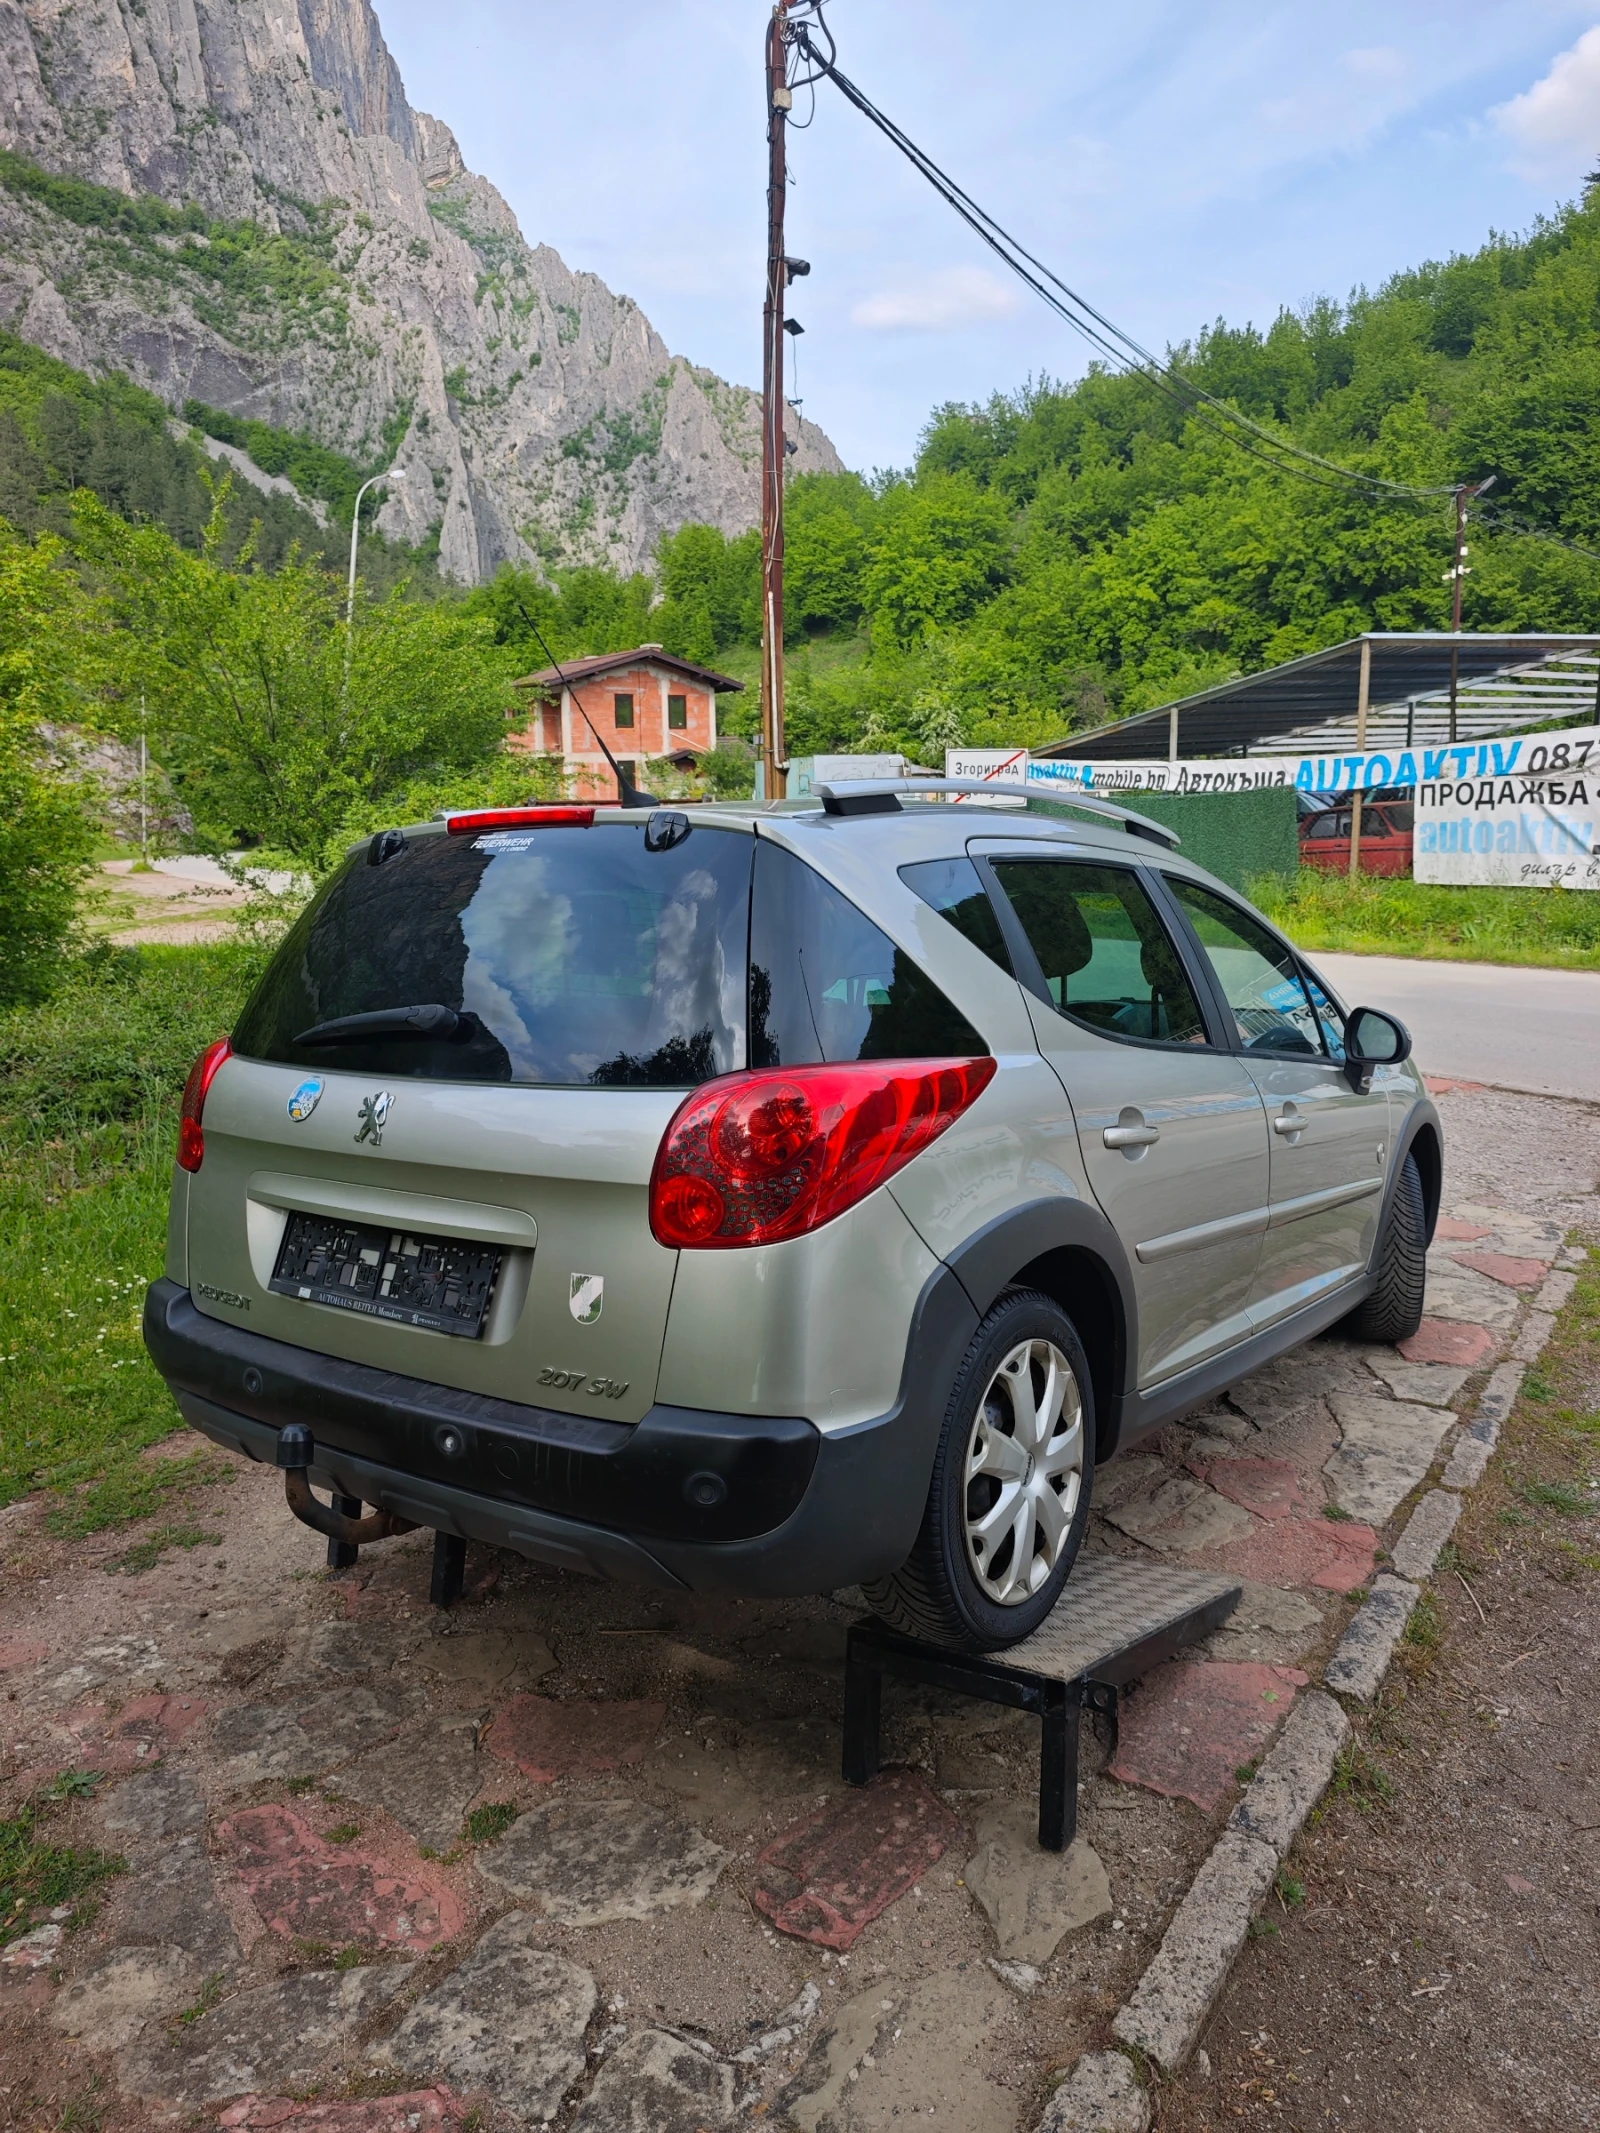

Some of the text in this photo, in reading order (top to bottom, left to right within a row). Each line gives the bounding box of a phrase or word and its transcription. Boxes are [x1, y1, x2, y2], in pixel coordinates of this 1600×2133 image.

[955, 762, 1019, 777] Згориград
[1294, 740, 1600, 791] AUTOAKTIV 087
[1420, 780, 1589, 811] ПРОДАЖБА
[470, 837, 535, 849] FEUERWEHR
[197, 1282, 252, 1311] PEUGEOT
[318, 1293, 403, 1319] AUTOHAUS REITER Mondsee
[537, 1367, 630, 1400] 207 SW
